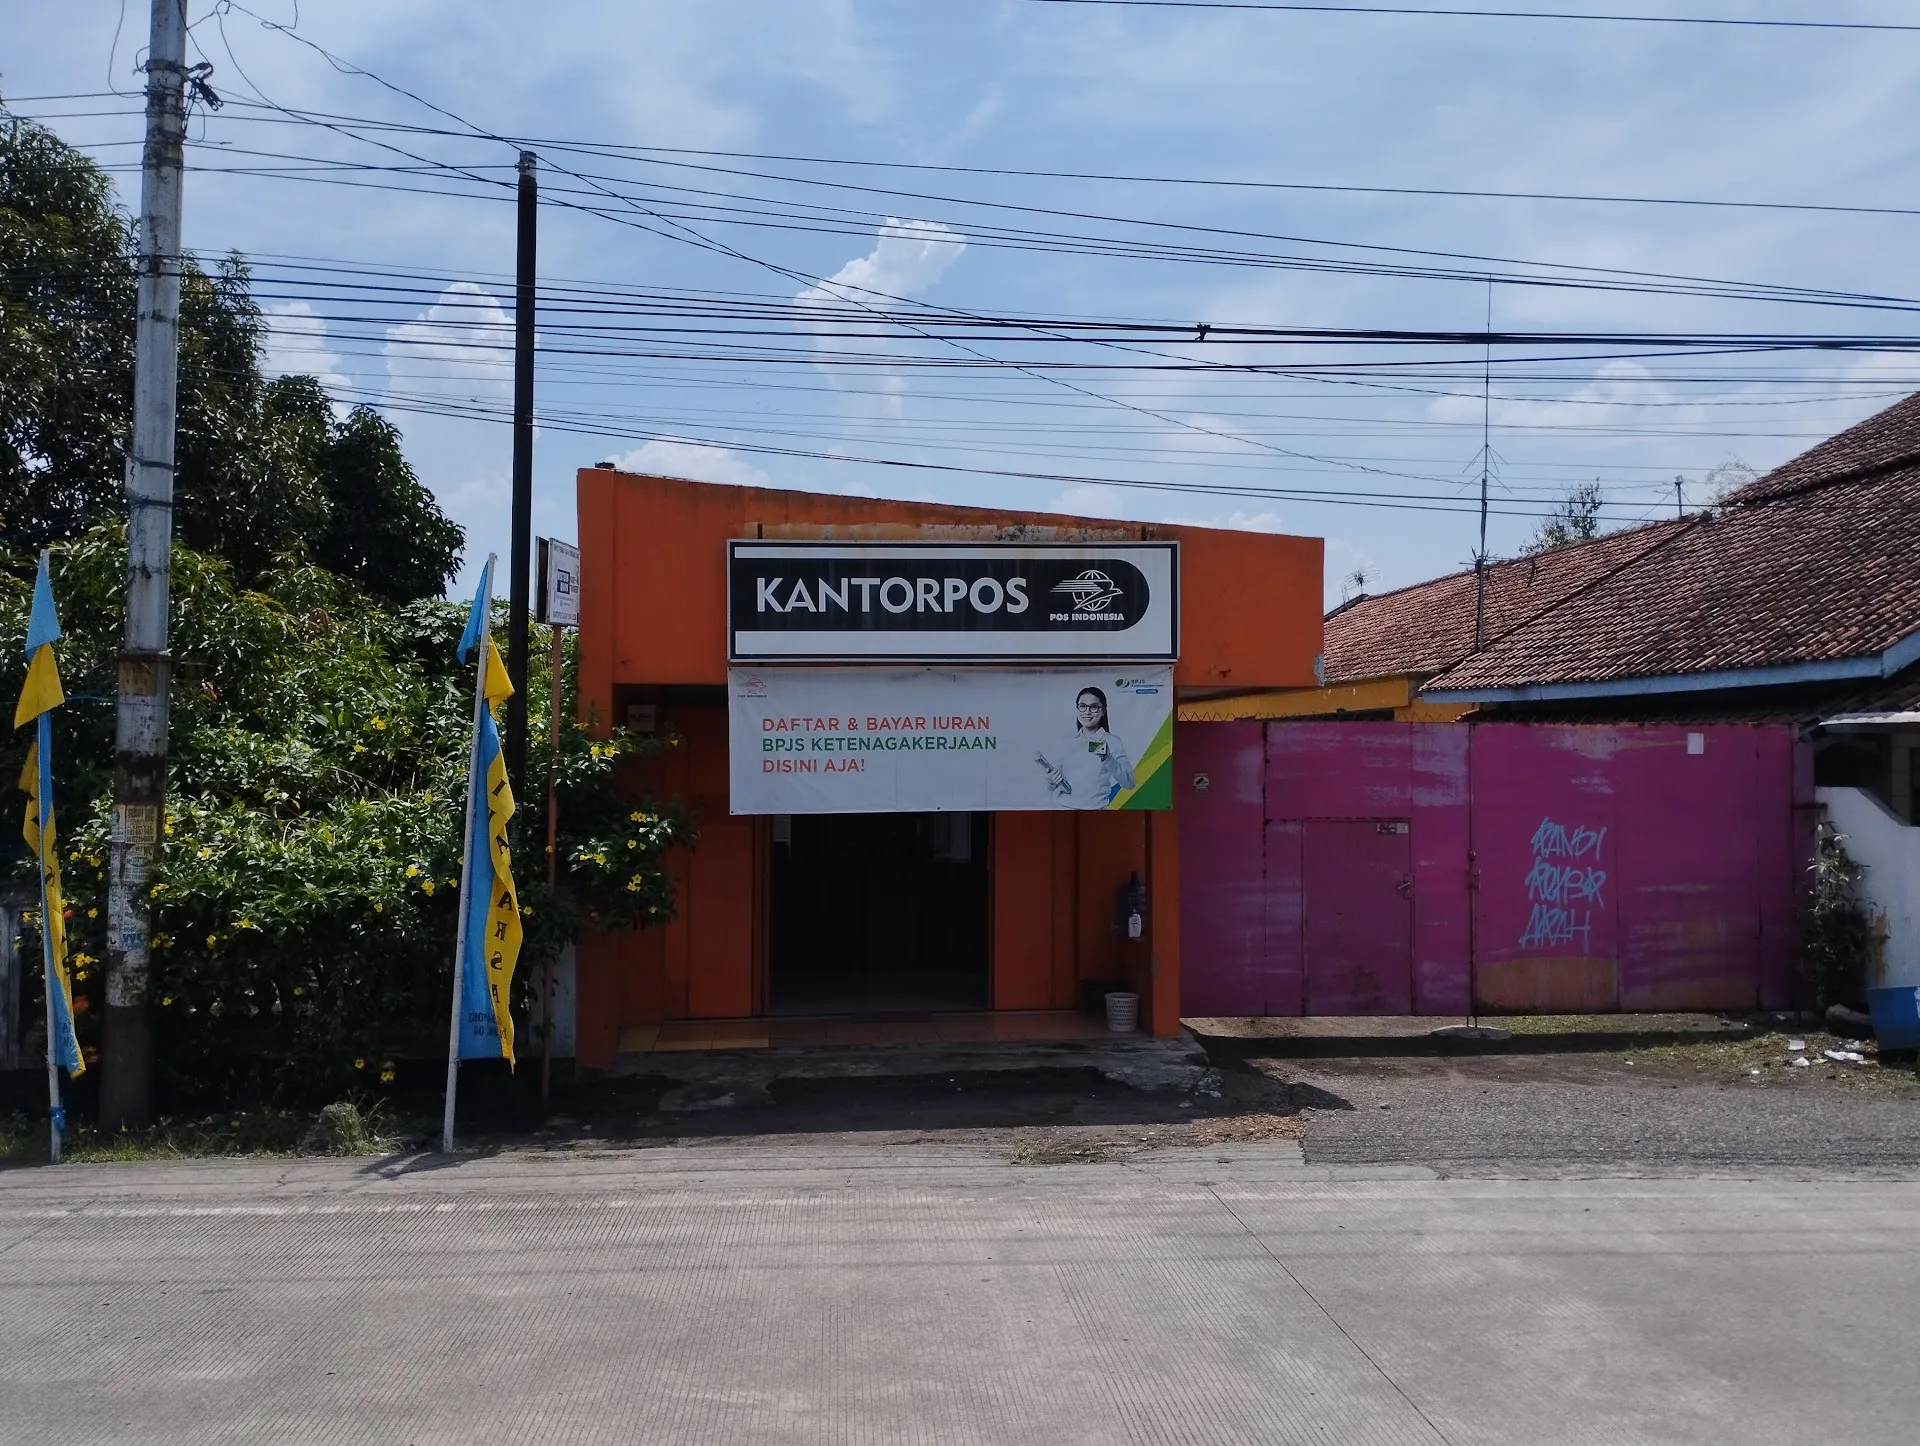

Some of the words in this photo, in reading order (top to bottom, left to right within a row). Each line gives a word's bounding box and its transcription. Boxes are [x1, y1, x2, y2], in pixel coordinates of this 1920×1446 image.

[756, 576, 1030, 614] KANTORPOS
[1049, 612, 1070, 621] POS
[1071, 612, 1125, 621] INDONESIA
[762, 717, 840, 732] DAFTAR
[847, 717, 859, 731] &
[866, 716, 926, 731] BAYAR
[932, 716, 990, 730] IURAN
[762, 738, 805, 752] BPJS
[811, 736, 997, 751] KETENAGAKERJAAN
[762, 759, 817, 773] DISINI
[823, 758, 866, 773] AJA!
